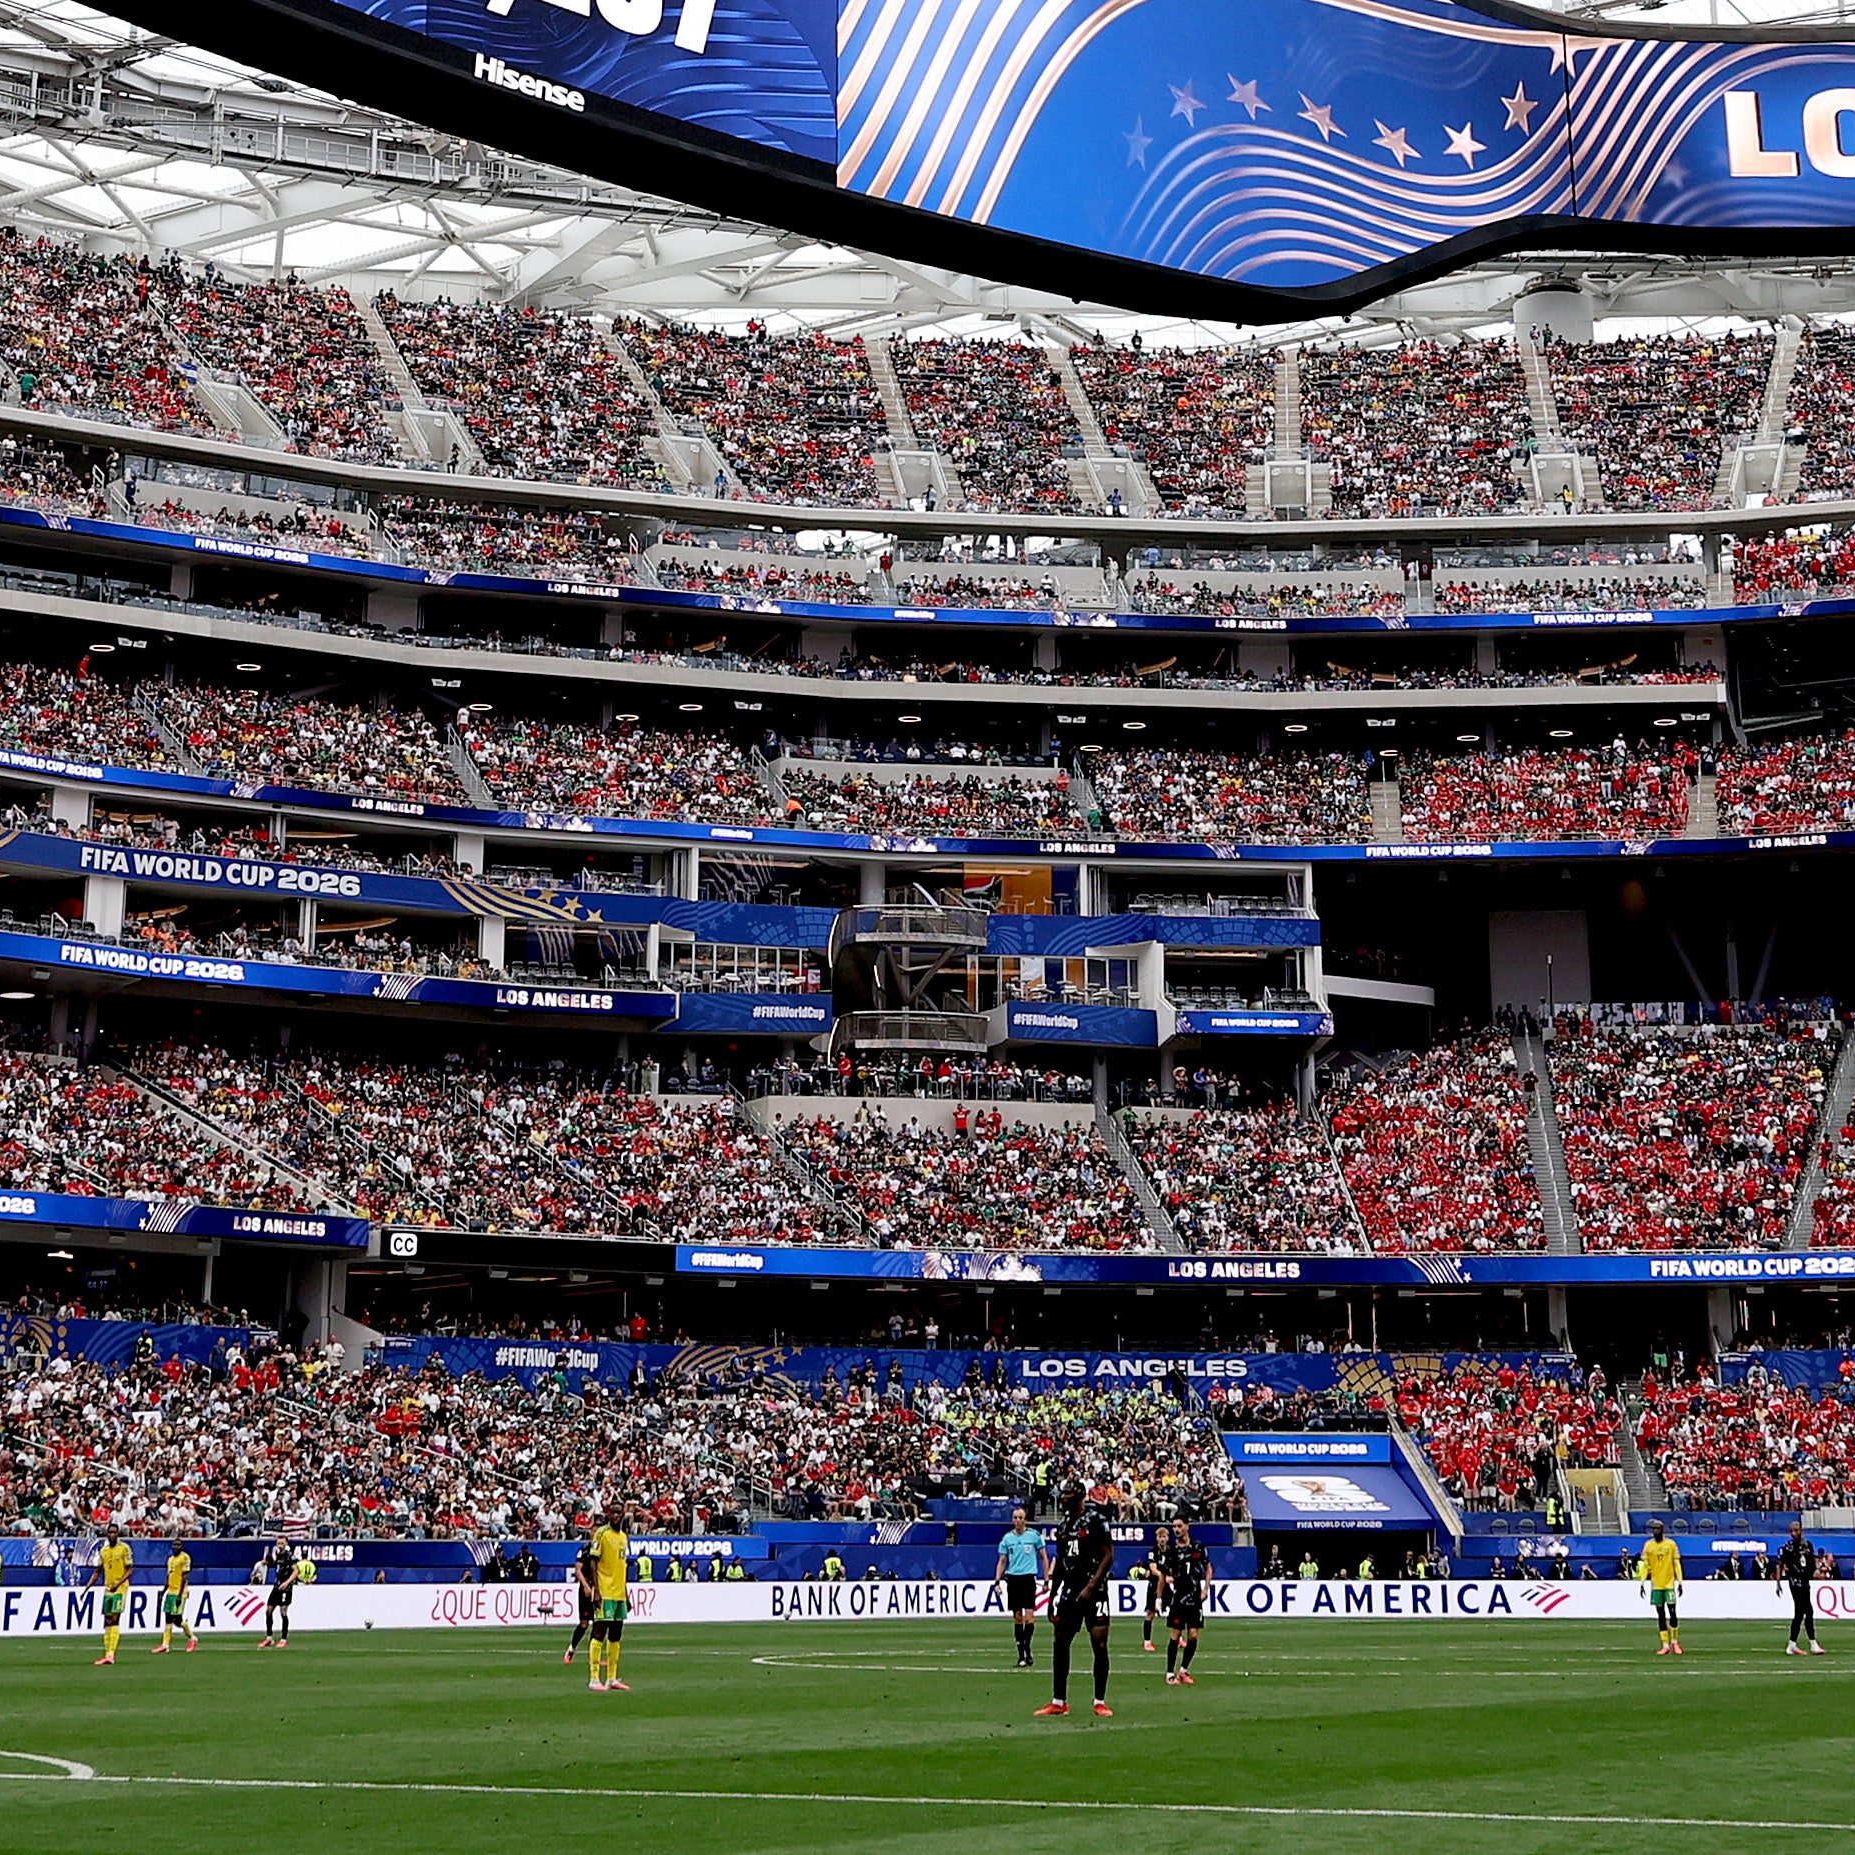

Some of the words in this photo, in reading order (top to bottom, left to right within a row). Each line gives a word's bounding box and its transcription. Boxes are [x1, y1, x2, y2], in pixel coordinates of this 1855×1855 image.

[473, 51, 586, 114] Hisense
[548, 584, 569, 593] LOS
[571, 585, 619, 597] ANGELES
[352, 798, 373, 809] LOS
[376, 801, 424, 815] ANGELES
[1040, 843, 1062, 852] LOS
[1064, 843, 1115, 853] ANGELES
[81, 847, 129, 873] FIFA
[134, 854, 222, 881] WORLD
[226, 863, 274, 886] CUP
[278, 869, 360, 896] 2026
[61, 945, 93, 964] FIFA
[95, 950, 147, 971] WORLD
[149, 958, 184, 974] CUP
[185, 961, 244, 980] 2026
[497, 989, 528, 1005] LOS
[532, 992, 612, 1009] ANGELES
[234, 1216, 261, 1232] LOS
[264, 1219, 325, 1236] ANGELES
[393, 1237, 414, 1252] CC
[1169, 1262, 1206, 1277] LOS
[1211, 1262, 1300, 1278] ANGELES
[1651, 1260, 1692, 1276] FIFA
[1693, 1259, 1762, 1276] WORLD
[1764, 1259, 1802, 1275] CUP
[1023, 1359, 1086, 1376] LOS
[629, 1542, 670, 1558] WORLD
[671, 1541, 693, 1556] CUP
[1067, 1540, 1081, 1557] 24
[495, 1588, 574, 1624] QUIERES
[771, 1585, 842, 1617] BANK
[850, 1584, 879, 1615] OF
[887, 1583, 1011, 1616] AMERICA
[1246, 1583, 1299, 1614] OF
[1312, 1583, 1513, 1614] AMERICA
